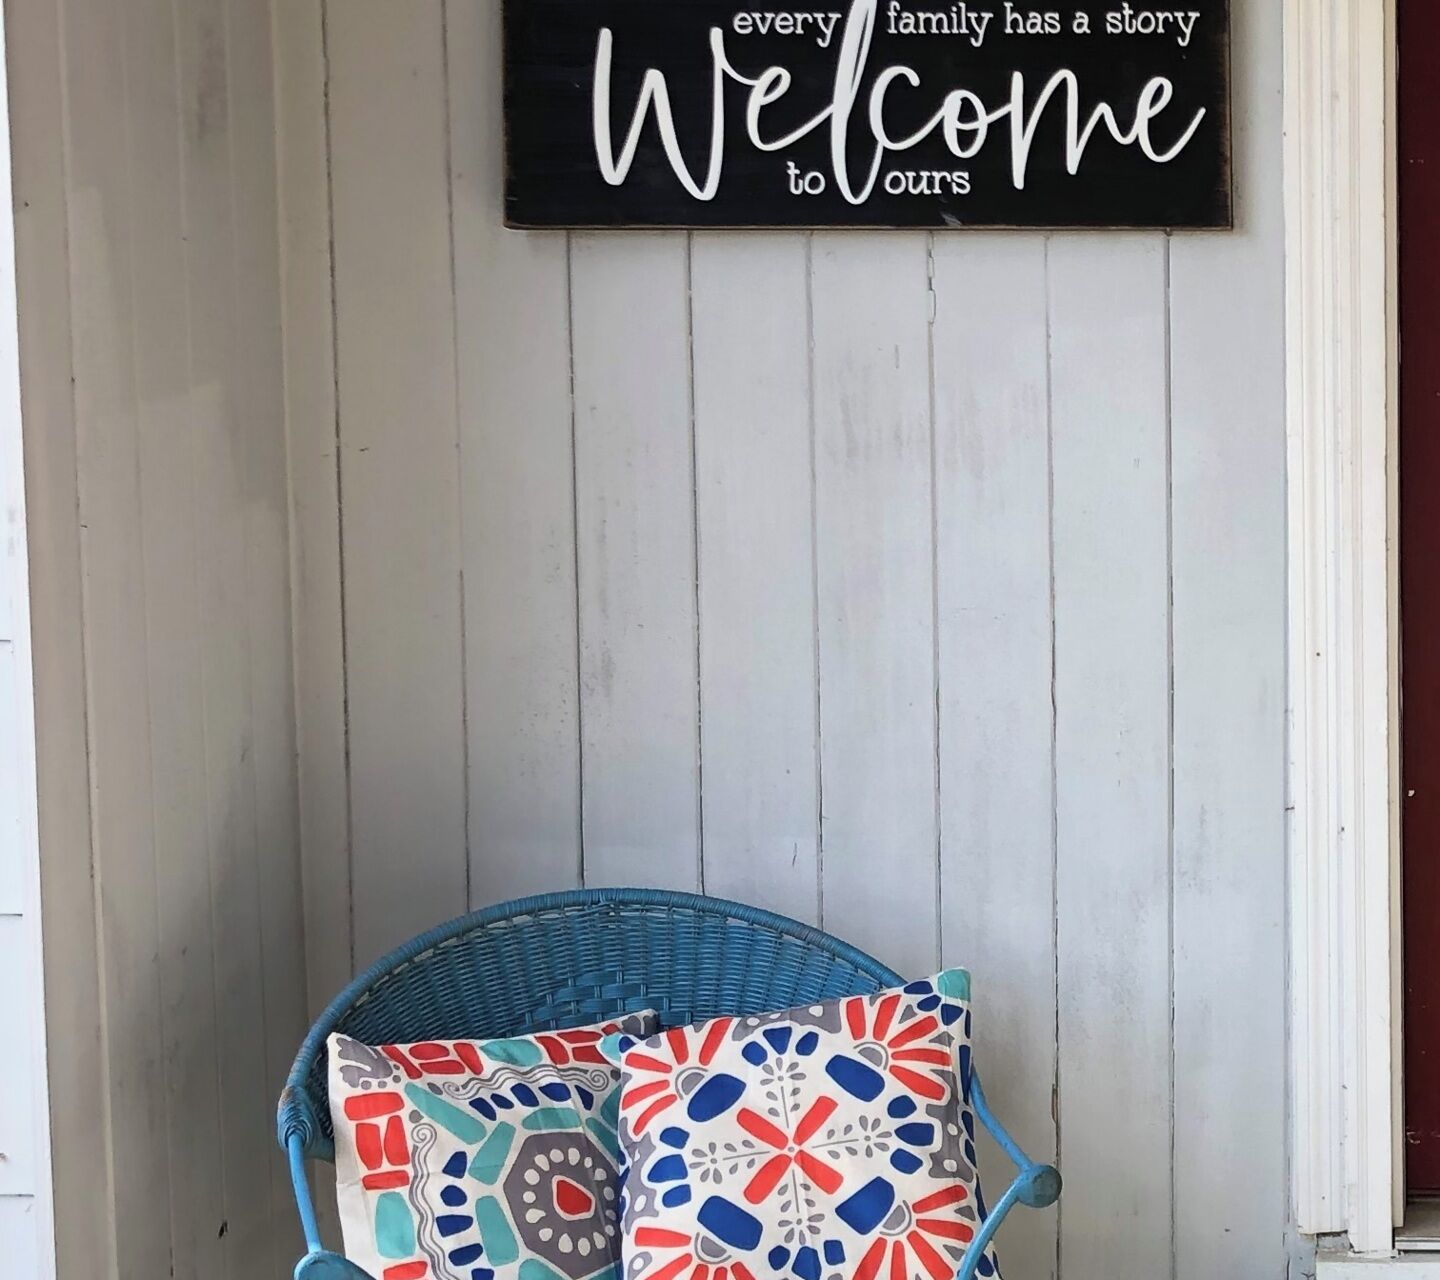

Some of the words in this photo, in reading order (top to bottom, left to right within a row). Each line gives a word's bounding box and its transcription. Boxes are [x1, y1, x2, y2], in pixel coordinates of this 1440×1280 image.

[733, 12, 842, 48] every
[887, 0, 994, 48] family
[1003, 1, 1061, 35] has
[1072, 11, 1091, 34] a
[1106, 2, 1201, 47] story
[786, 160, 826, 195] to
[884, 170, 971, 195] ours
